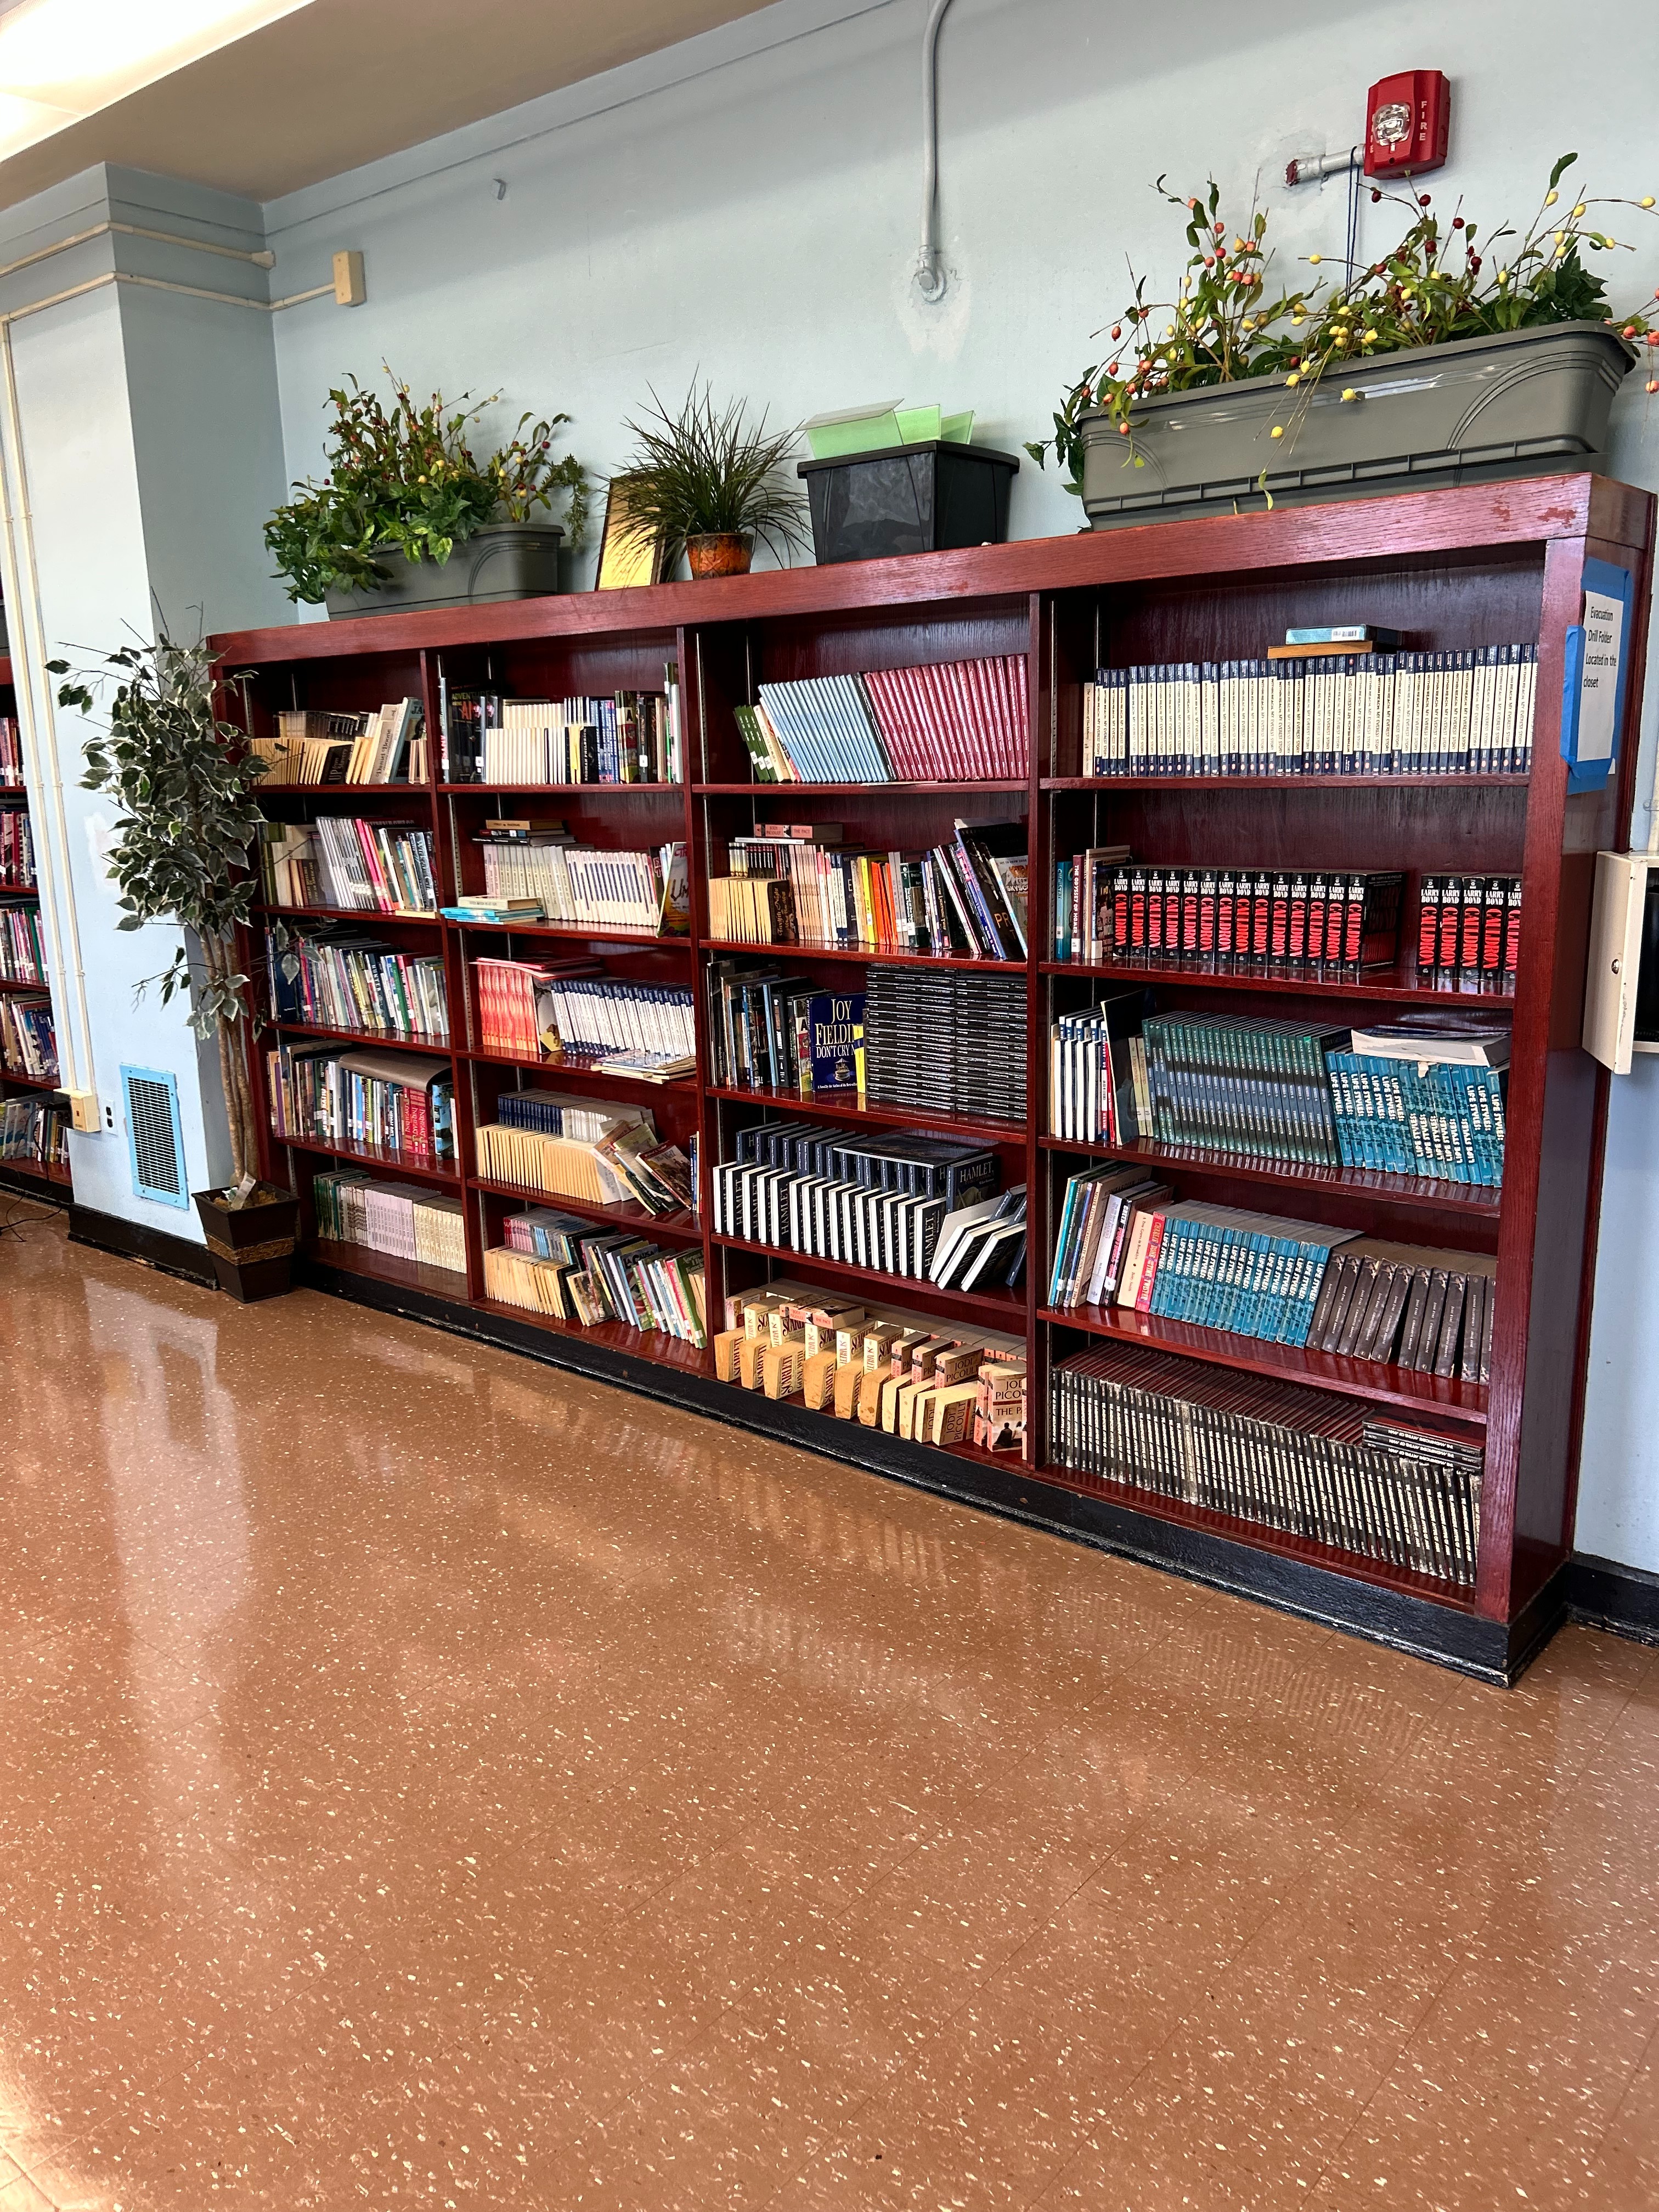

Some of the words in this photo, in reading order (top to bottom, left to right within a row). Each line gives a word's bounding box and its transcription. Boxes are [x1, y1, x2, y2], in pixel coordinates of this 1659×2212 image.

[1419, 101, 1427, 141] FIRE
[1590, 606, 1613, 621] Evacuation
[1588, 630, 1598, 643] Drill
[1598, 631, 1612, 645] Folder
[1585, 652, 1604, 666] Located
[1583, 675, 1598, 689] closet
[938, 895, 946, 918] LIGHTNING
[1115, 894, 1127, 945] CAULDRON
[1184, 896, 1197, 950] CAULDRON
[1254, 899, 1268, 953] CAULDRON
[1290, 901, 1305, 956] CAULDRON
[1327, 903, 1341, 960] CAULDRON
[1419, 906, 1436, 965] CAULDRON
[1440, 907, 1457, 966] CAULDRON
[1463, 907, 1479, 967] CAULDRON
[1483, 909, 1502, 968] CAULDRON
[371, 964, 381, 991] HUNTER
[831, 999, 852, 1024] JOY
[815, 1023, 854, 1046] FIELDI
[816, 1046, 837, 1058] DON'T
[838, 1045, 850, 1057] CRY
[781, 1355, 793, 1395] SCARLETT
[946, 1365, 979, 1382] PICOULT
[955, 1358, 973, 1371] JODI
[996, 1390, 1021, 1400] PICO
[946, 1413, 956, 1434] JODI
[954, 1403, 966, 1440] PICOULT
[996, 1408, 1013, 1416] THE
